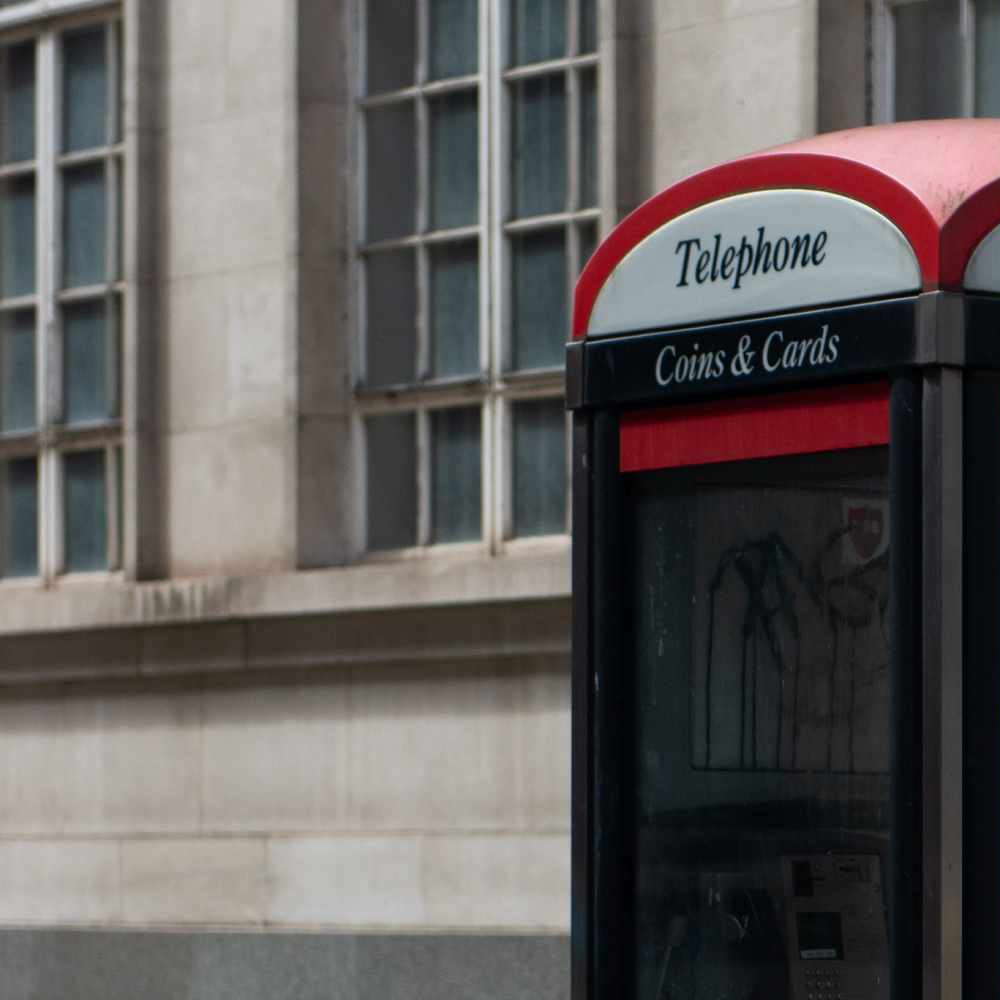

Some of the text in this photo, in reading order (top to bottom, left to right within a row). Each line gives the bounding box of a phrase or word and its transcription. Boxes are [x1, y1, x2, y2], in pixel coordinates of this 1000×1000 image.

[675, 226, 828, 290] Telephone
[655, 324, 840, 386] Coins & Cards
